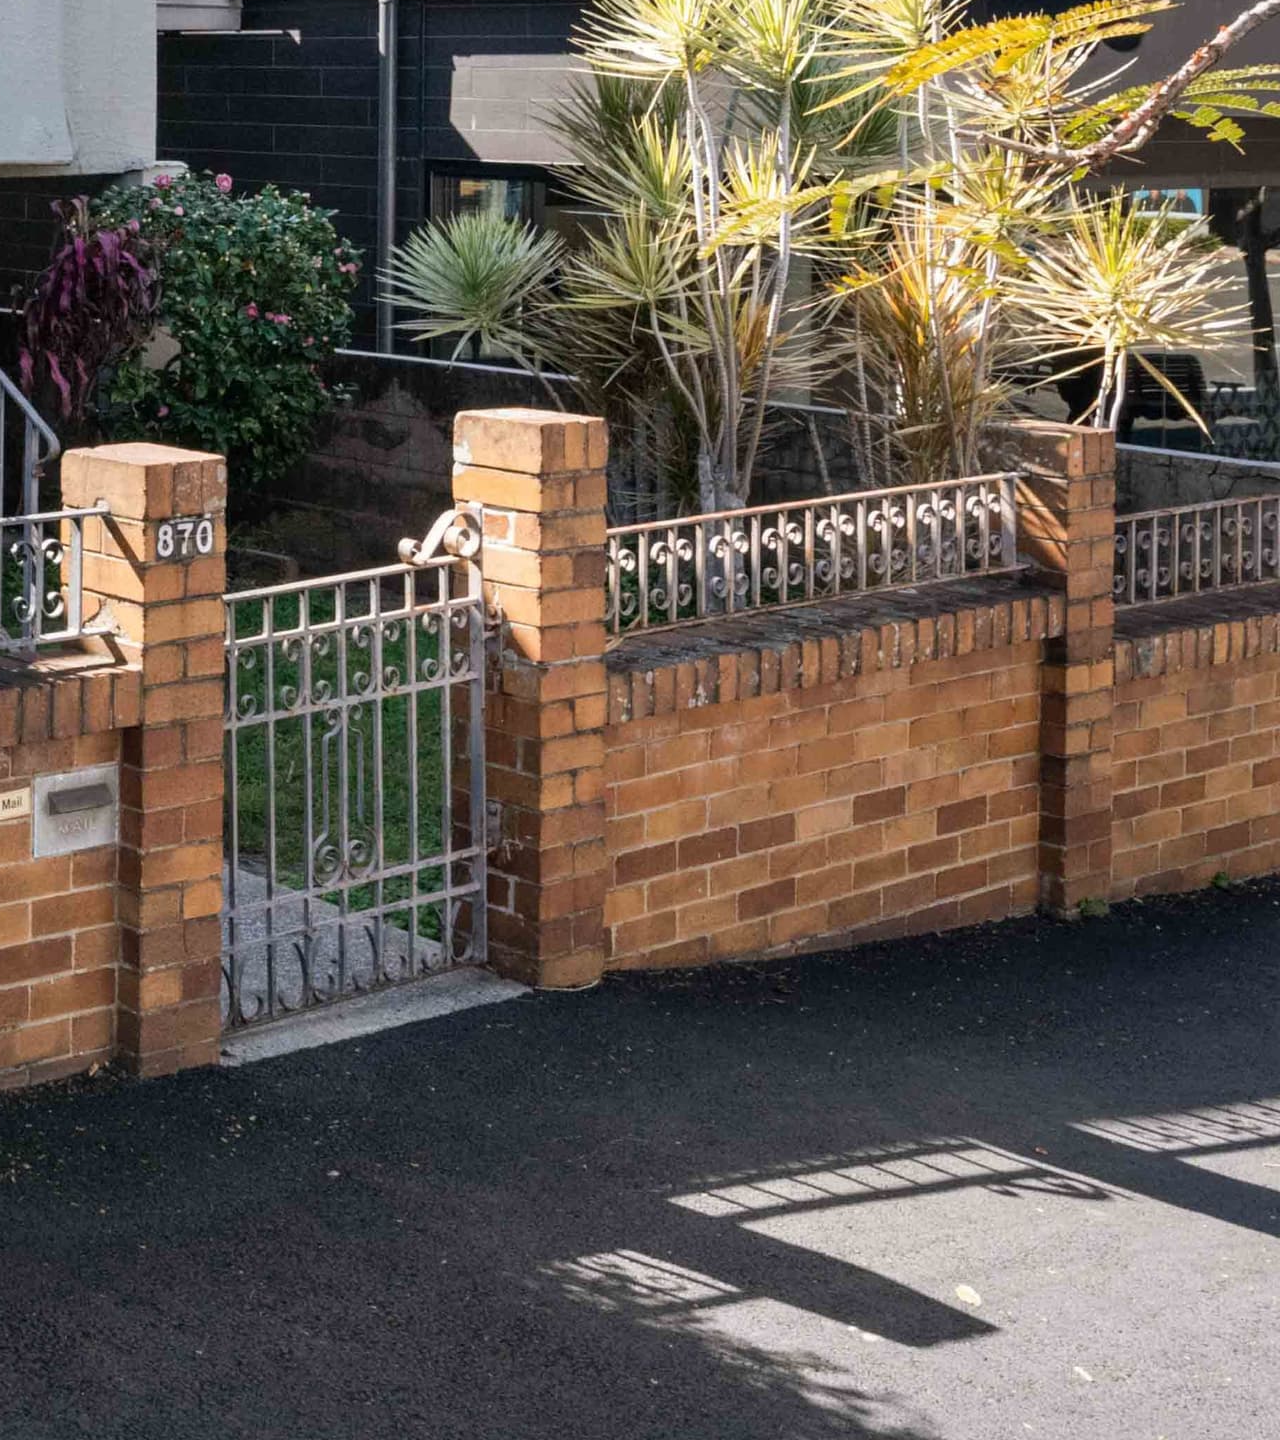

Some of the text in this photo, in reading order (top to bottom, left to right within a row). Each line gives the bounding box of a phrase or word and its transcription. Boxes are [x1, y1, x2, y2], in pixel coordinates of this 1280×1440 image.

[157, 519, 213, 558] 870
[1, 795, 23, 811] Mail
[58, 816, 97, 834] MAIL
